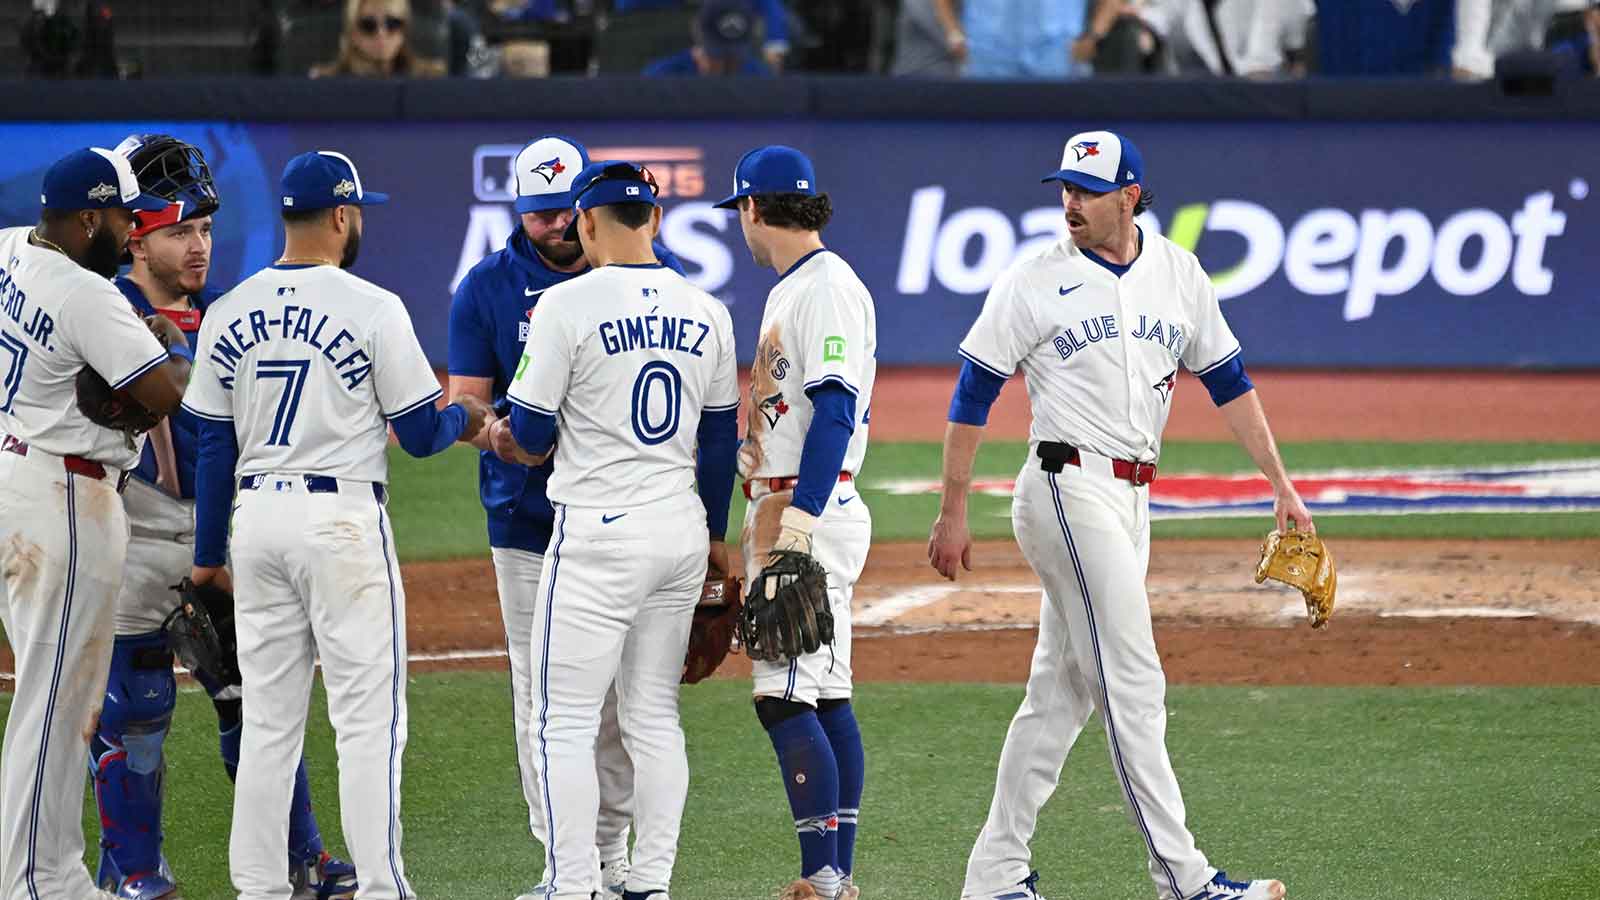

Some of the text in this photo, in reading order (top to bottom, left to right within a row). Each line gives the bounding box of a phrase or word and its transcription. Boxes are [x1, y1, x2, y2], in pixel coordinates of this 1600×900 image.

[897, 186, 1566, 321] loaDepot
[24, 307, 55, 352] JR.
[599, 306, 710, 358] GIMÉNEZ
[1053, 315, 1120, 360] BLUE
[256, 360, 311, 446] 7
[631, 360, 682, 446] 0
